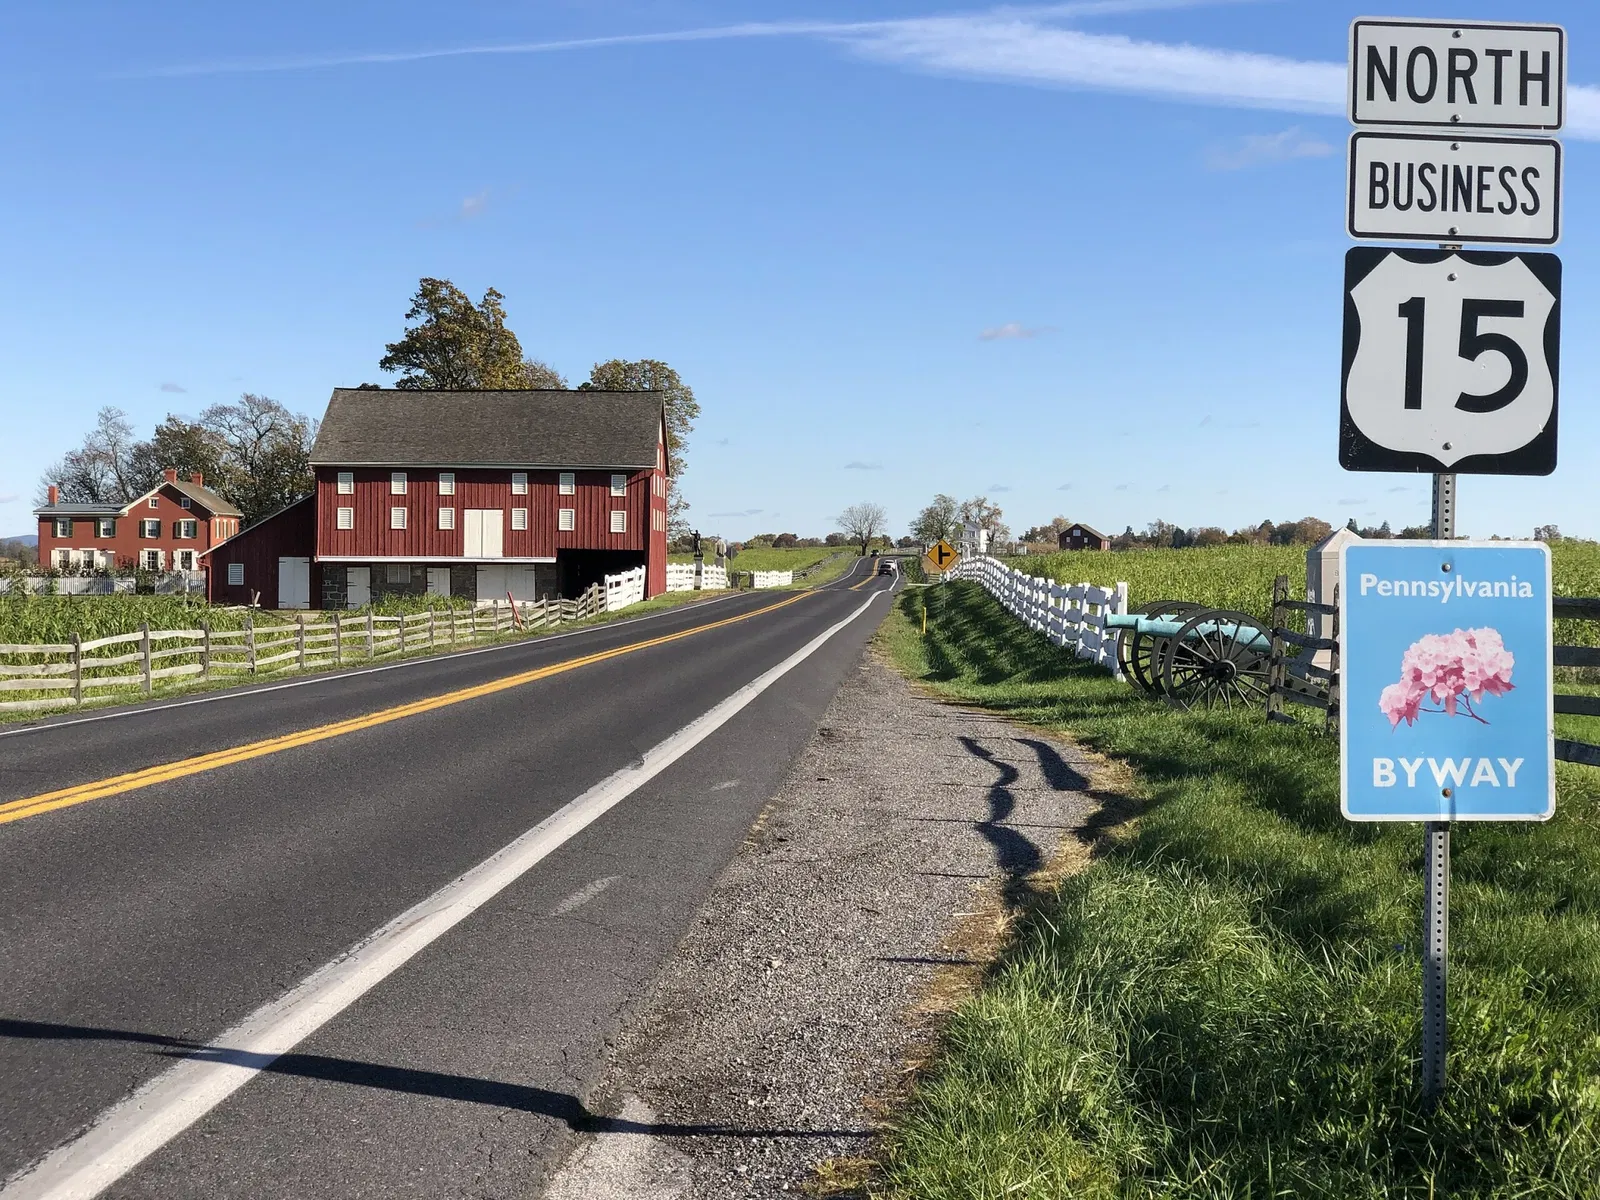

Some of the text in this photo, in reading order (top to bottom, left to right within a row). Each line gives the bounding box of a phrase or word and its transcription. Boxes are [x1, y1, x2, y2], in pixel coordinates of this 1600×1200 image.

[1366, 45, 1550, 106] NORTH
[1369, 162, 1541, 216] BUSINESS
[1397, 296, 1529, 413] 15
[1360, 573, 1534, 604] Pennsylvania
[1373, 757, 1524, 788] BYWAY
